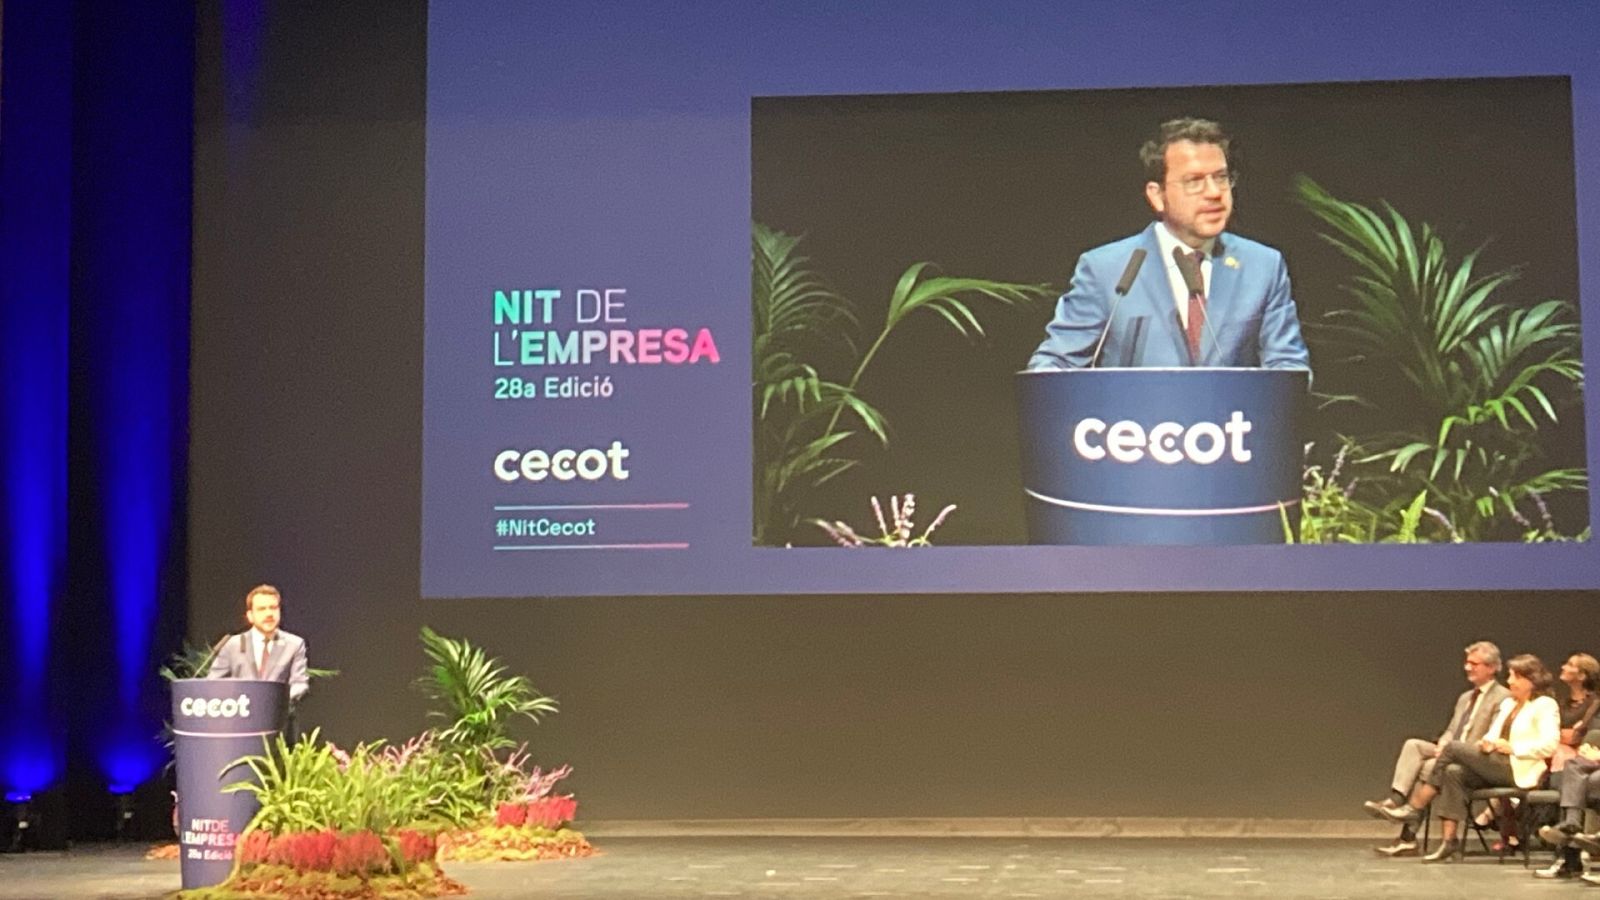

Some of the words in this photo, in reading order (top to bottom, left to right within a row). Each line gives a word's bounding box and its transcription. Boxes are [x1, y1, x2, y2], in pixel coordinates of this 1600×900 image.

[494, 290, 561, 325] NIT
[576, 289, 627, 323] DE
[494, 328, 720, 366] L'EMPRESA
[494, 377, 536, 399] 28a
[545, 376, 614, 398] Edició
[1074, 411, 1252, 464] cecot
[494, 441, 630, 481] cecot
[496, 518, 596, 537] #NitCecot
[180, 695, 250, 717] cecot
